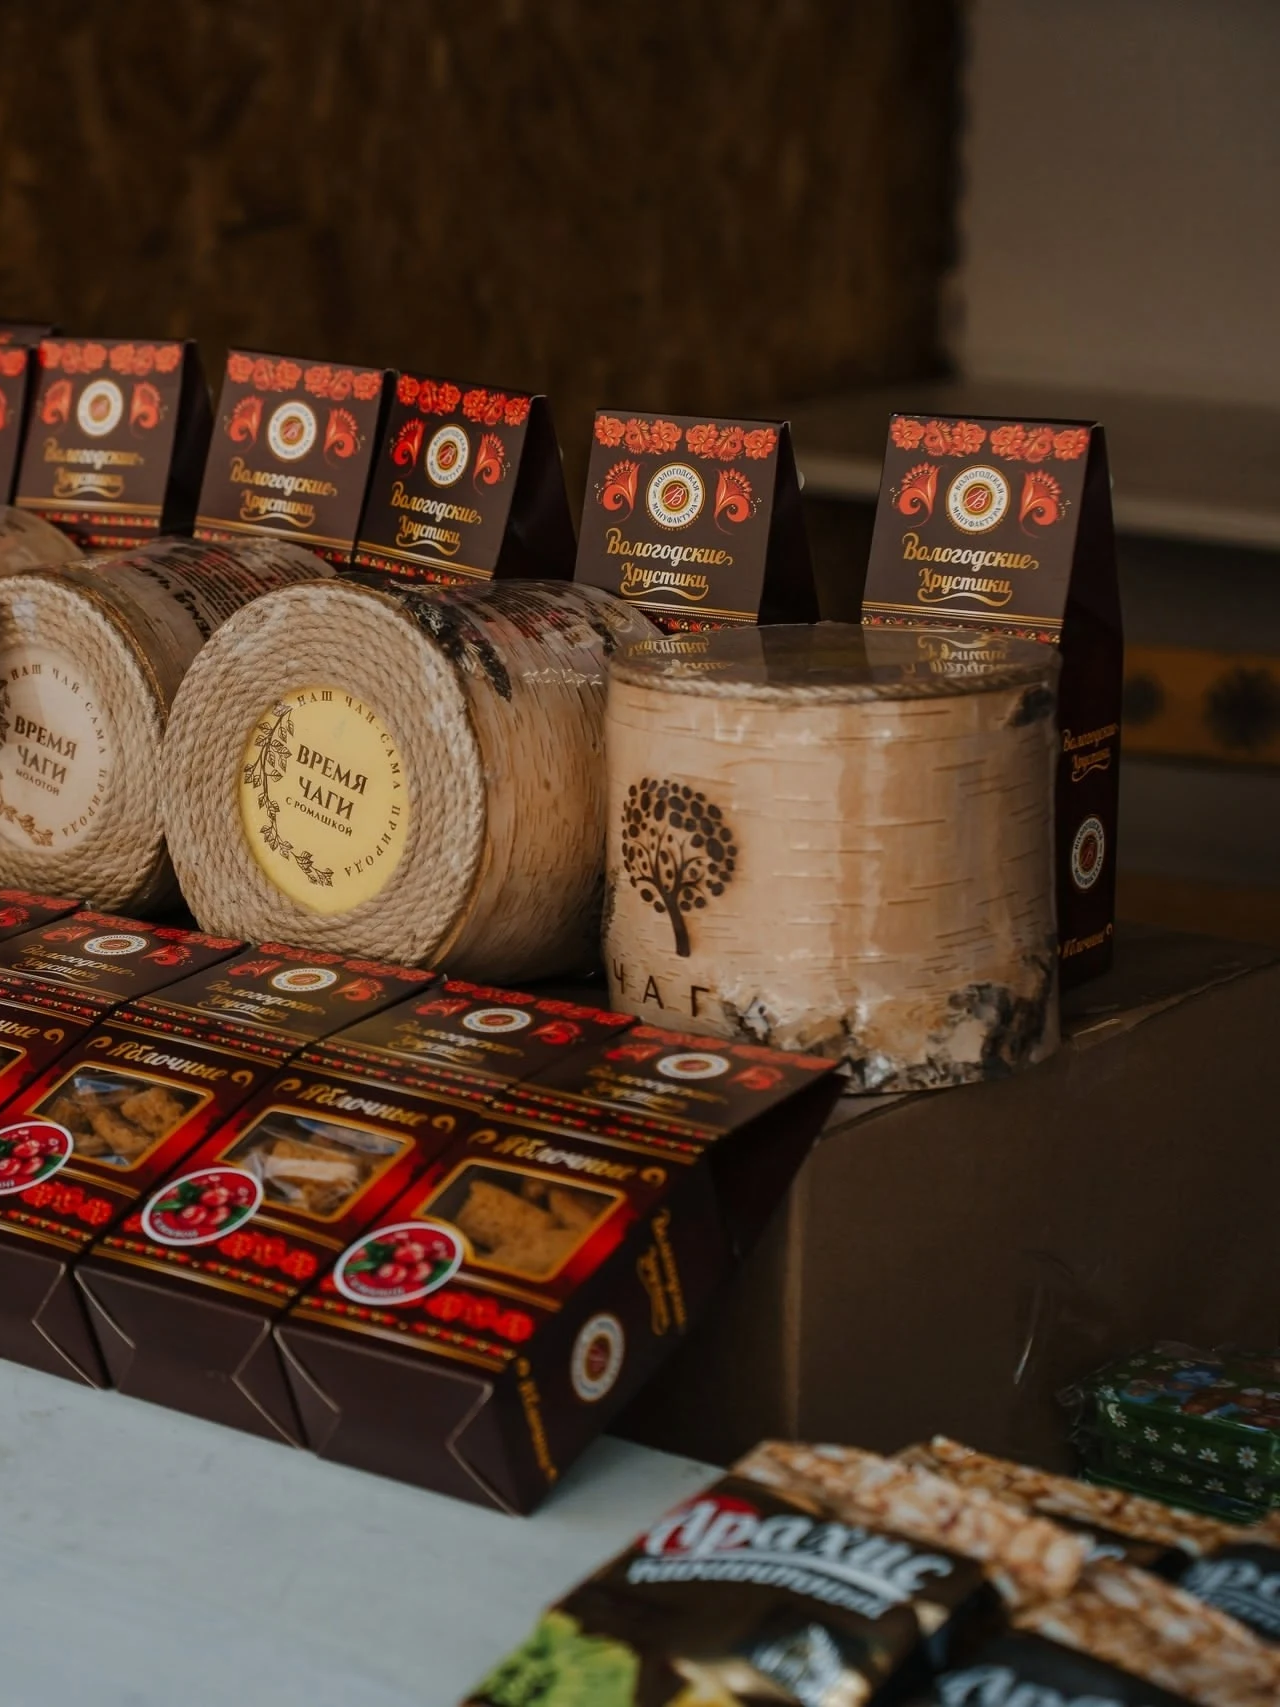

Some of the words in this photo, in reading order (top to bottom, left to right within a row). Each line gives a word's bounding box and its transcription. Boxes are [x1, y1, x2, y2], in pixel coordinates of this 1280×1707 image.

[391, 481, 481, 523] Вологодские
[606, 528, 733, 566] Вологодские
[902, 532, 1039, 572] Вологодские
[621, 562, 709, 596] Хрустики
[918, 568, 1012, 602] Хрустики
[296, 690, 333, 707] НАШ
[14, 714, 77, 761] ВРЕМЯ
[17, 744, 67, 784] ЧАГИ
[296, 743, 368, 795] ВРЕМЯ
[380, 732, 402, 790] САМА
[298, 775, 354, 820] ЧАГИ
[293, 801, 353, 837] РОМАШКОЙ
[344, 804, 402, 878] ПРИРОДА
[108, 1041, 228, 1081] Яблочные
[645, 1500, 954, 1598] Арахис
